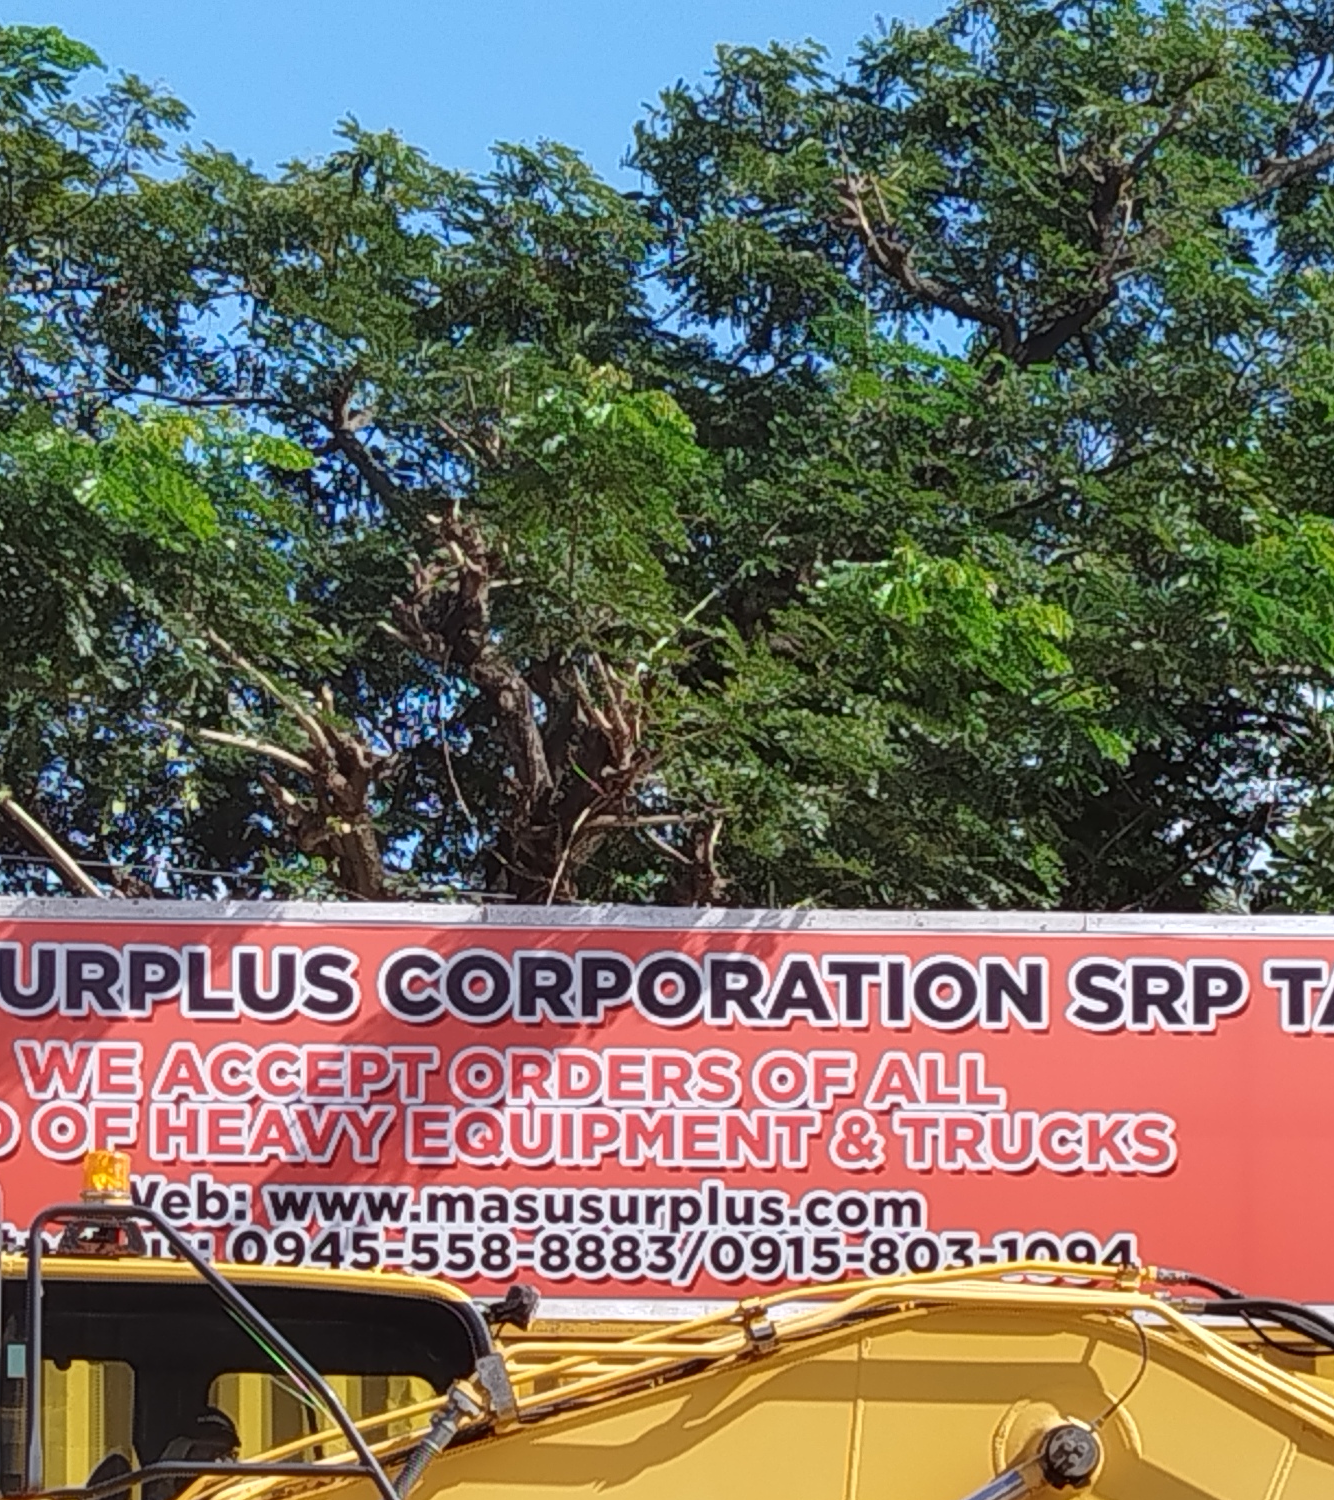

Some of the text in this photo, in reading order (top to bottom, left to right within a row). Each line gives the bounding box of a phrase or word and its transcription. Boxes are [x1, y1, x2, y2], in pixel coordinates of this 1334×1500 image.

[381, 948, 1047, 1028] CORPORATION
[1068, 959, 1247, 1031] SRP
[16, 1041, 1005, 1109] WE ACCEPT ORDERS OF ALL
[32, 1102, 136, 1153] OF
[151, 1104, 394, 1162] HEAVY
[407, 1110, 819, 1167] EQUIPMENT
[831, 1114, 884, 1167] &
[896, 1116, 1175, 1172] TRUCKS
[268, 1184, 924, 1235] www.masusurplus.com
